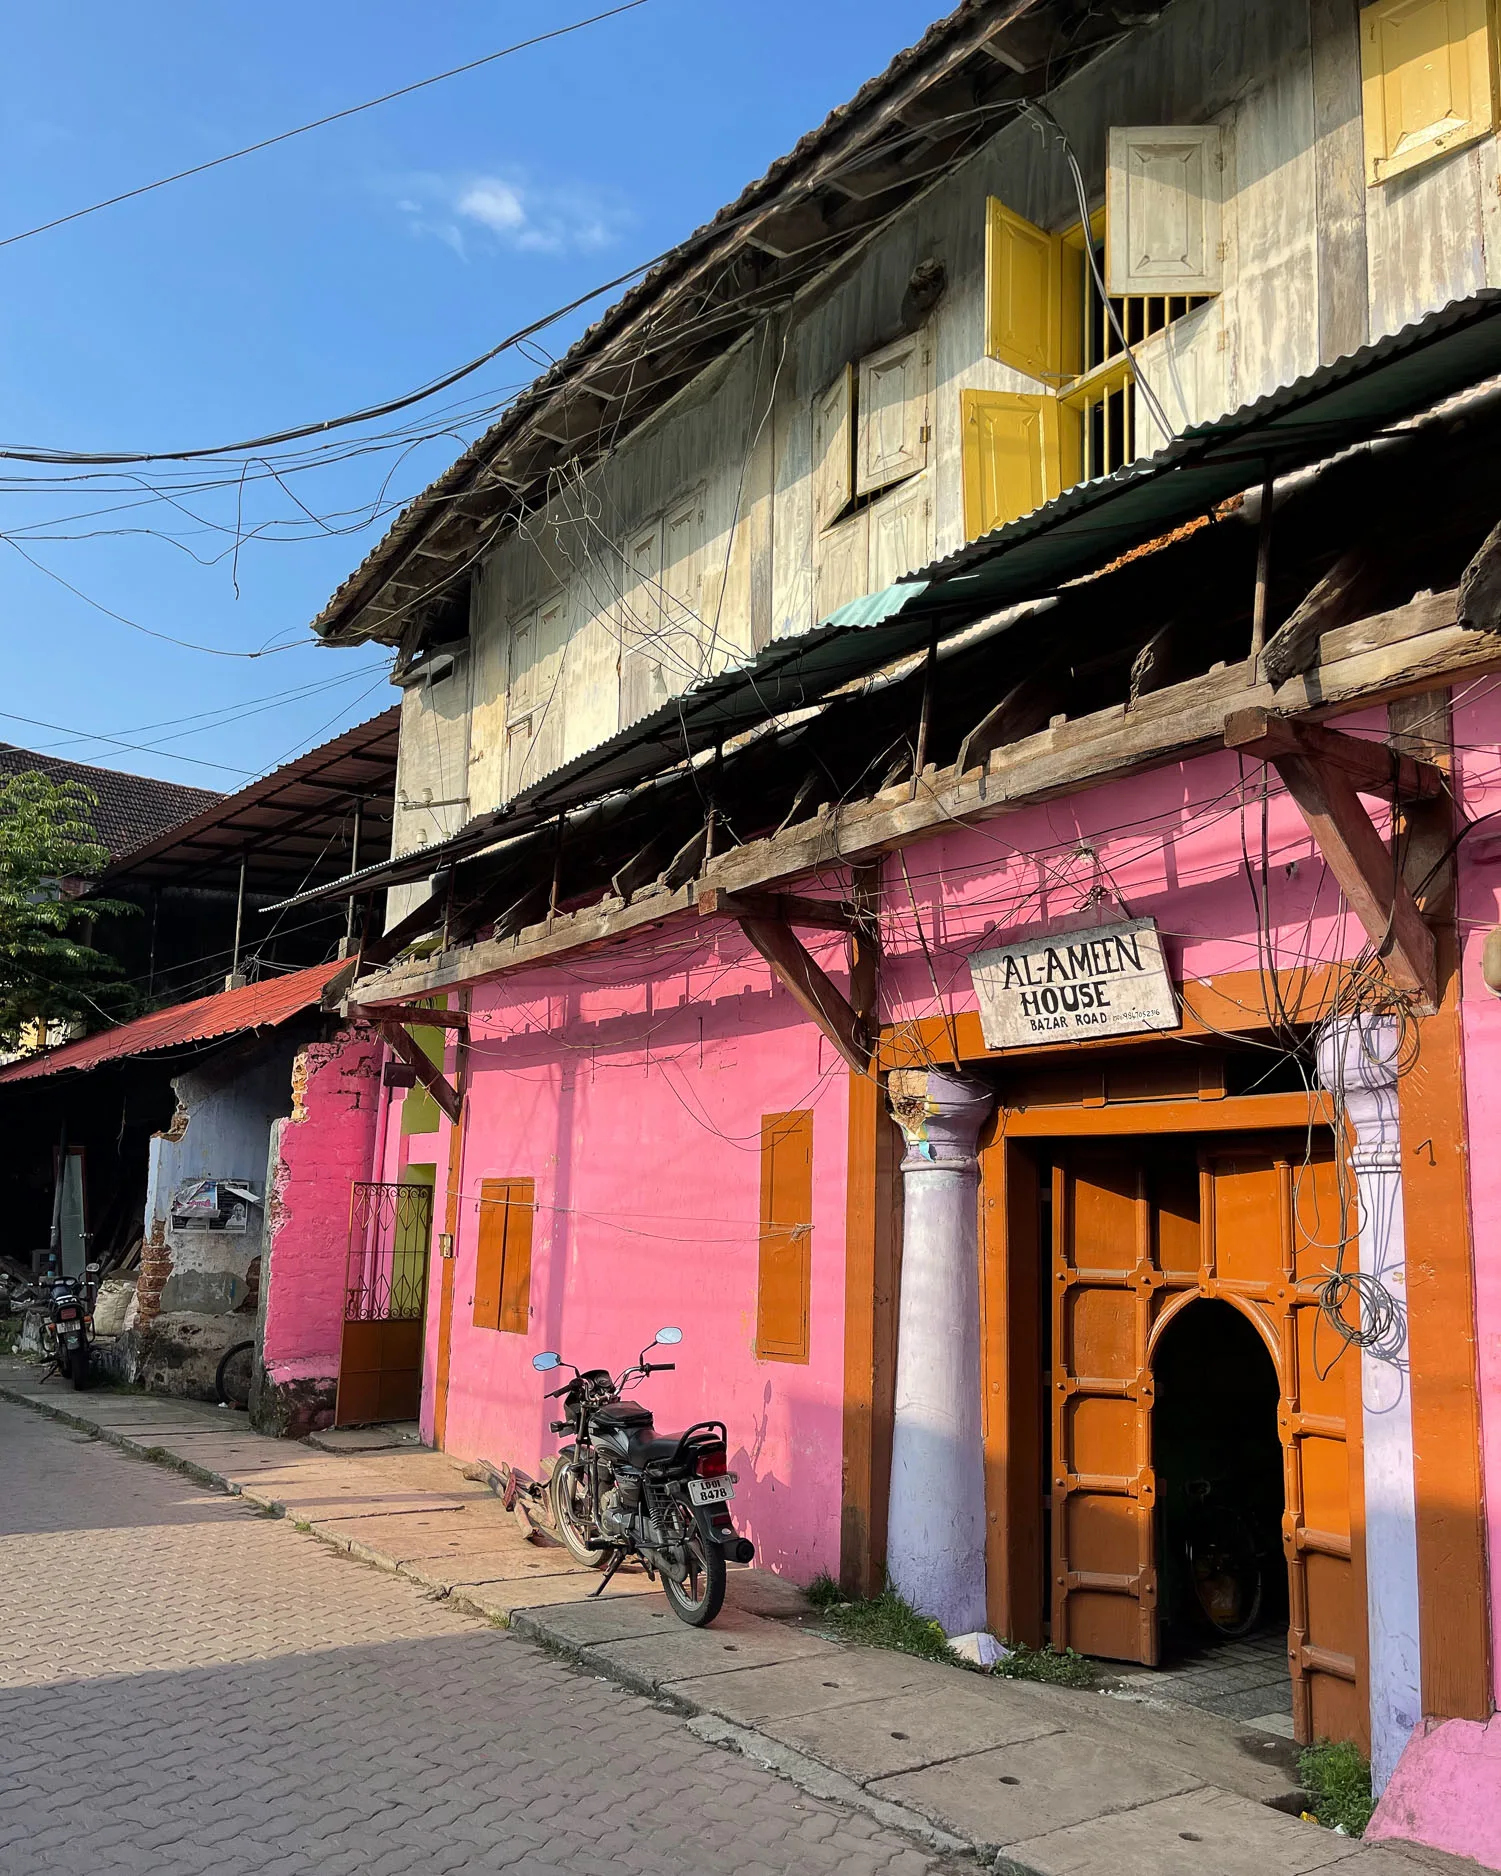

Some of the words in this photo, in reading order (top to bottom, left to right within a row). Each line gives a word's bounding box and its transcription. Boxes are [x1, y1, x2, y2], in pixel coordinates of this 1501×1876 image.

[1002, 933, 1146, 990] AL-AMEEN
[1020, 980, 1111, 1017] HOUSE
[1030, 1017, 1069, 1032] BAZAR
[1076, 1011, 1108, 1026] ROAD
[700, 1479, 721, 1491] LD01
[700, 1487, 727, 1501] 8478
